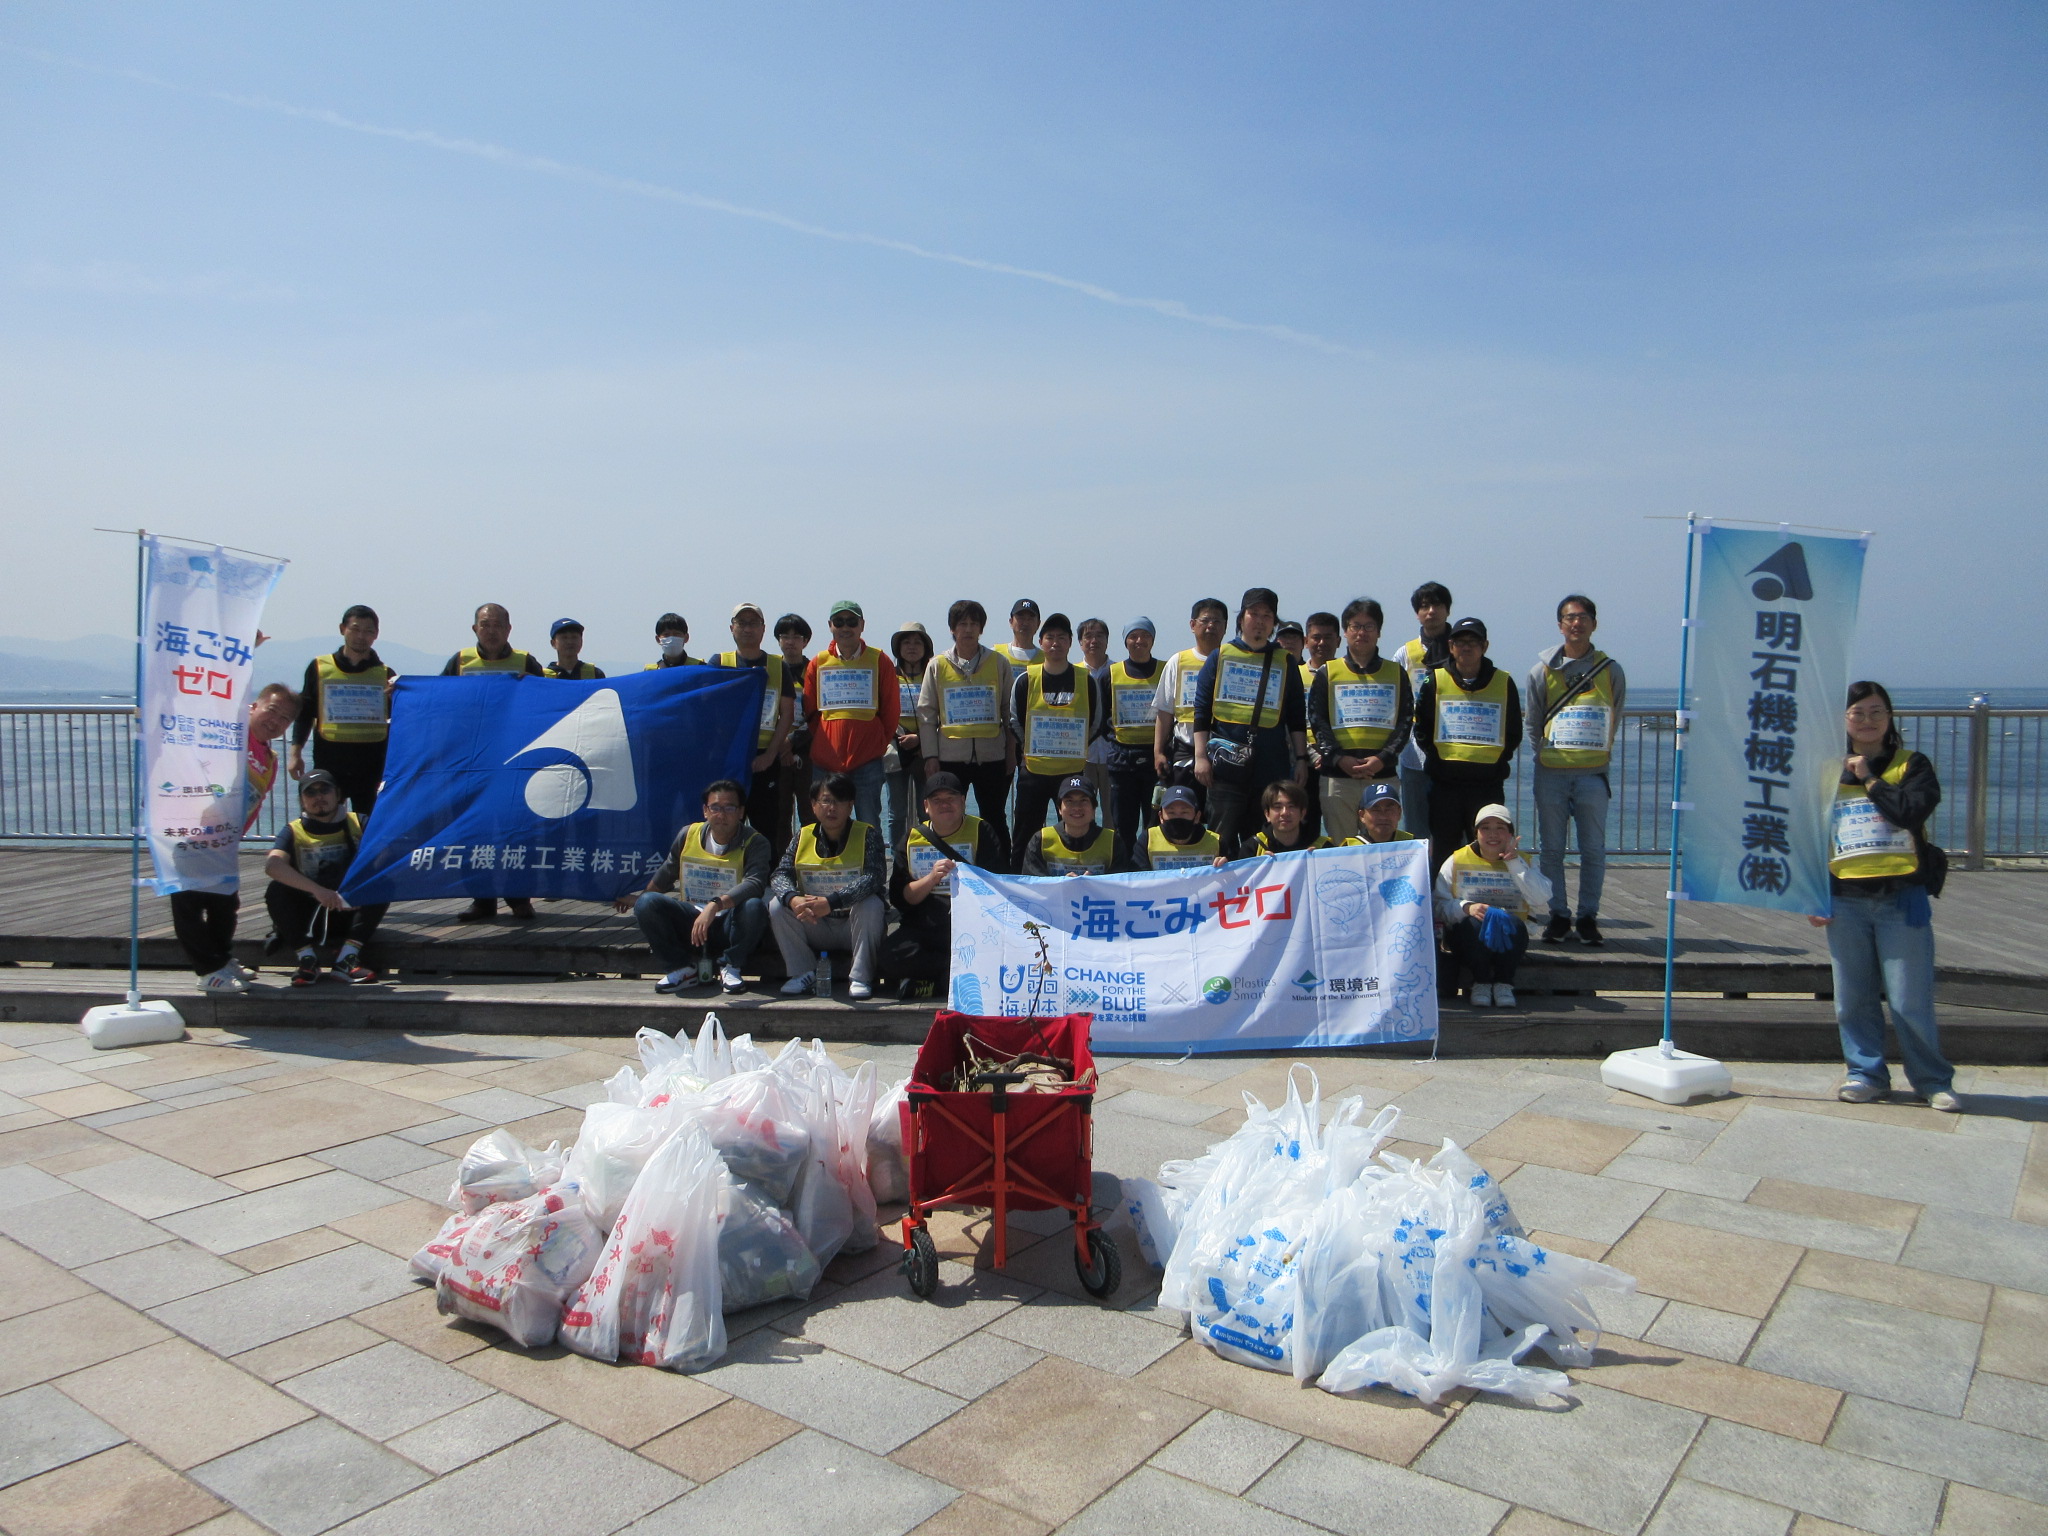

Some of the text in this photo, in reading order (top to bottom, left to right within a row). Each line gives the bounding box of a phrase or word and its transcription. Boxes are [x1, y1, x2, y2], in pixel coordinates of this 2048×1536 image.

[155, 620, 253, 667] 海ごみ
[172, 664, 233, 700] ゼロ
[198, 718, 244, 731] CHANGE
[219, 735, 244, 746] BLUE
[1070, 883, 1293, 943] 海ごみゼロ
[1064, 967, 1146, 985] CHANGE
[1234, 977, 1276, 989] Plastics
[1102, 985, 1146, 995] FOR THE
[1329, 976, 1380, 993] 環境省
[1234, 989, 1267, 1001] Smart
[1292, 994, 1318, 1002] Ministry
[1340, 991, 1380, 1000] Environment
[1102, 996, 1146, 1012] BLUE
